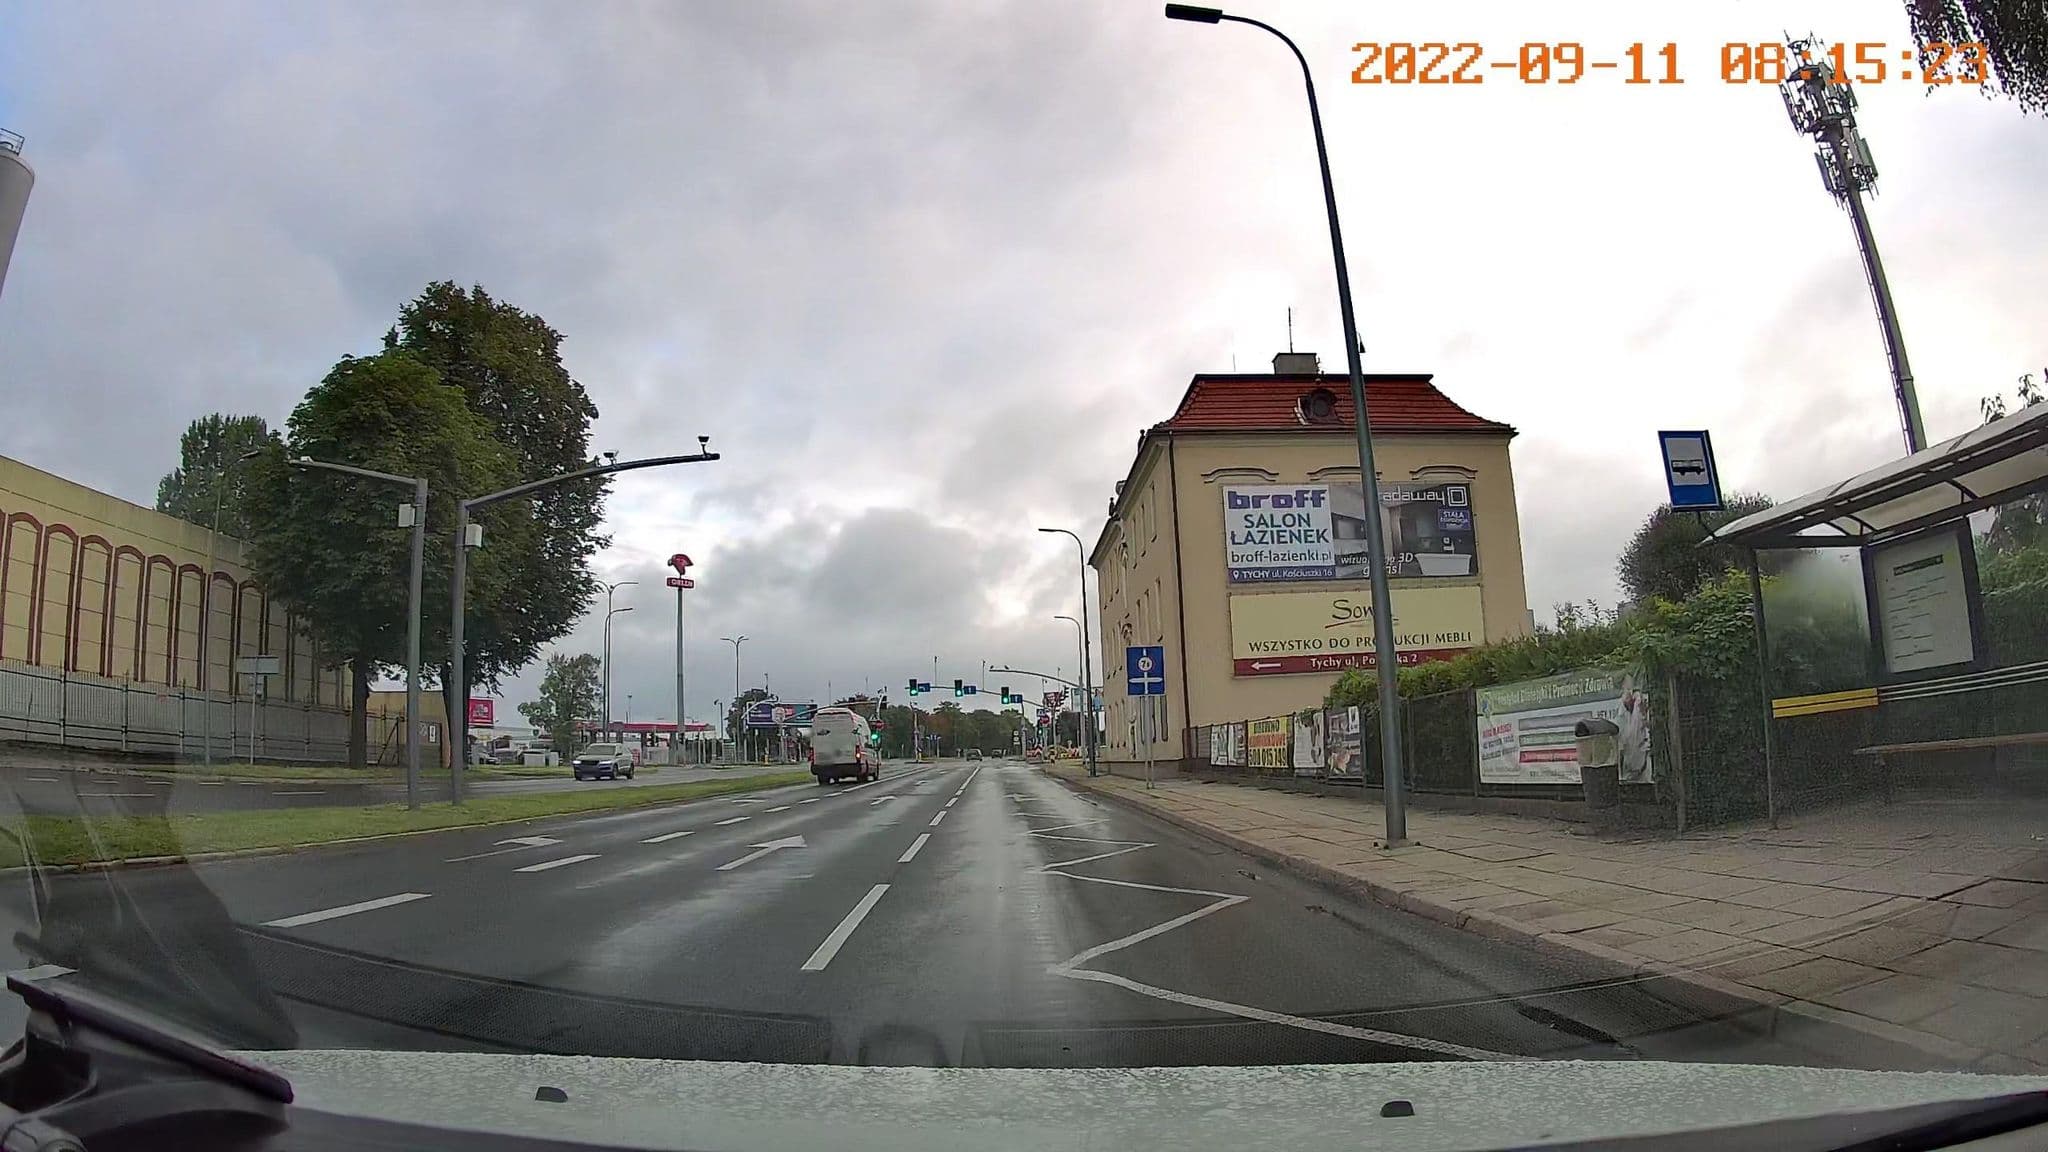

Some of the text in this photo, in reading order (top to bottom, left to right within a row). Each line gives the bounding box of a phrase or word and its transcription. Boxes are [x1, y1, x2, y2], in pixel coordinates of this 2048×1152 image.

[1228, 489, 1327, 510] broff
[1382, 486, 1446, 506] adaway
[1243, 512, 1311, 529] SALON
[1230, 528, 1330, 546] ŁAZIENEK
[1398, 552, 1414, 563] 3D
[1242, 570, 1270, 579] TYCHY
[1323, 568, 1333, 577] 16
[1249, 638, 1323, 652] WSZYSTKO
[1329, 636, 1350, 648] DO
[1435, 631, 1472, 643] MEBLI
[1310, 657, 1342, 669] Tychy
[1411, 653, 1418, 663] 2
